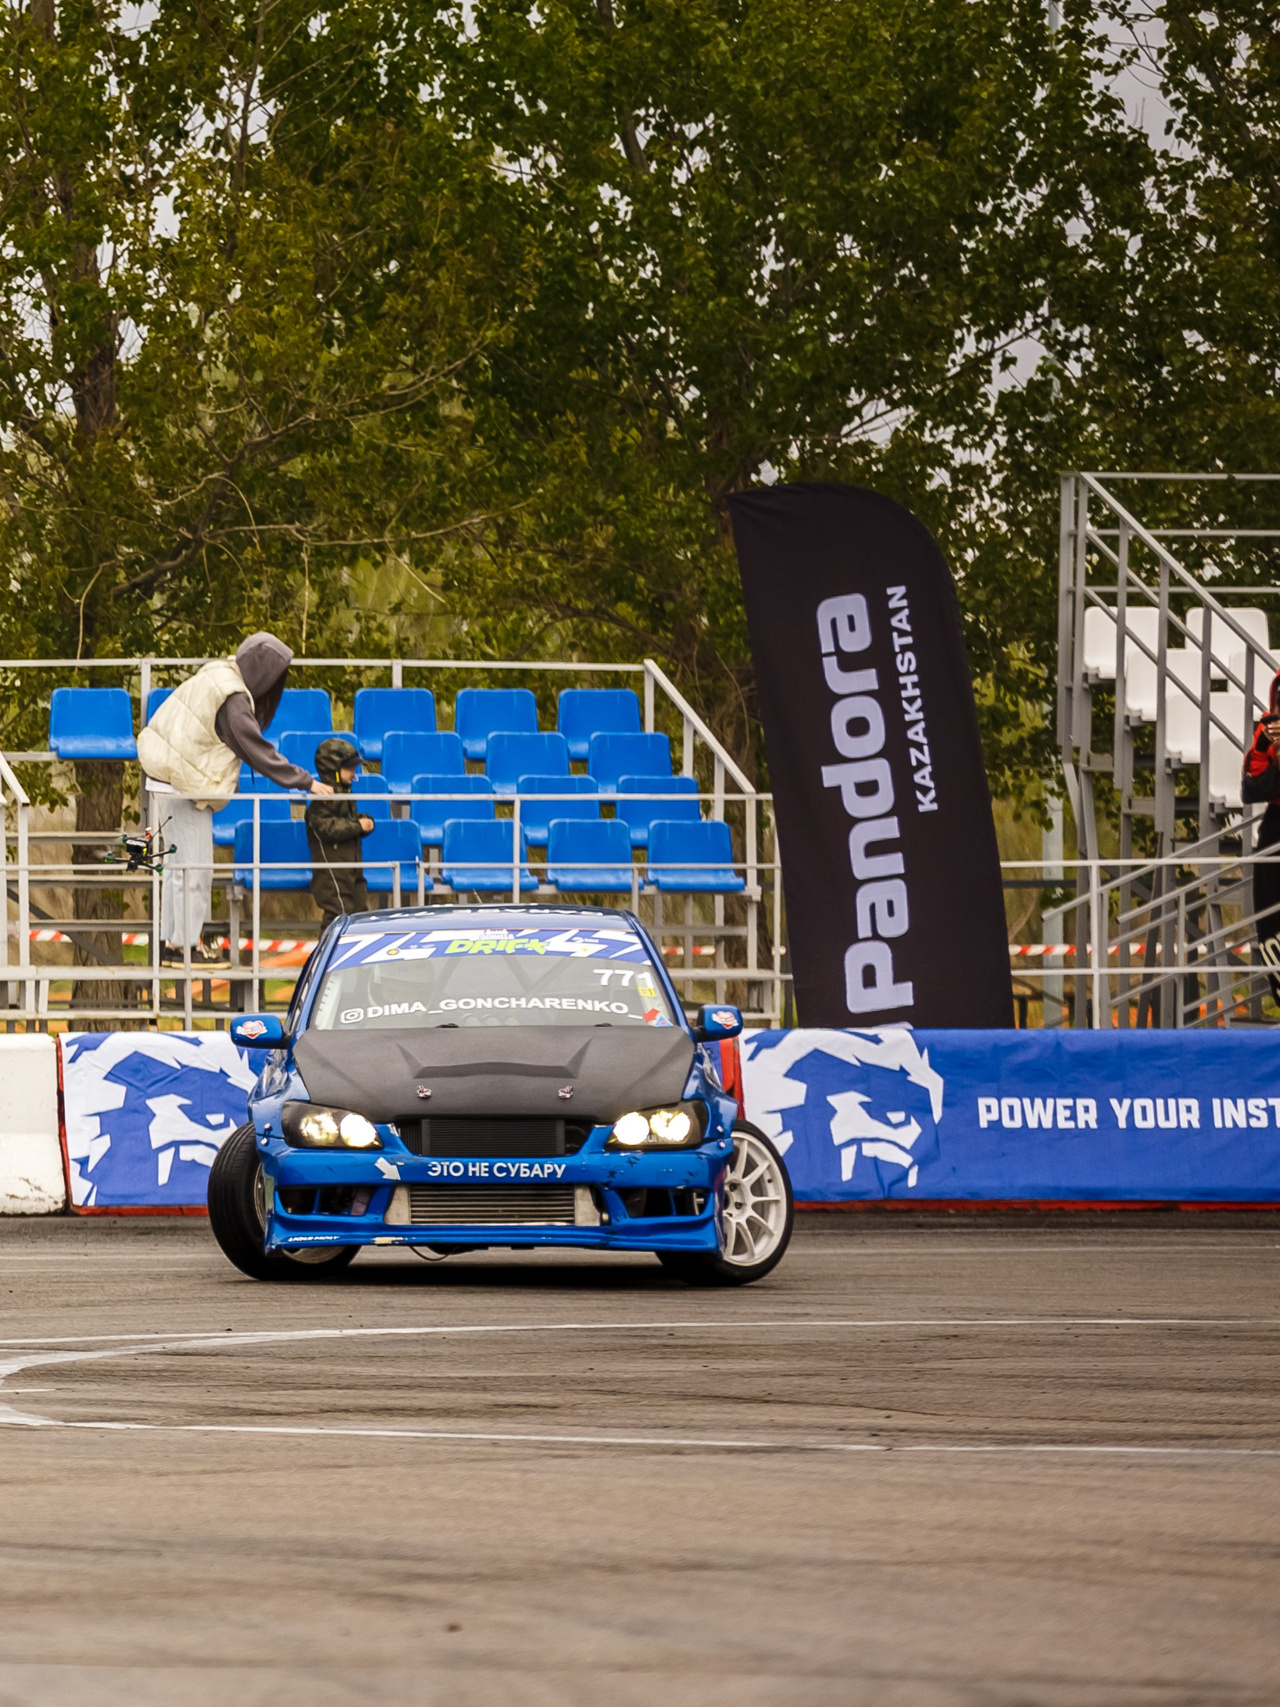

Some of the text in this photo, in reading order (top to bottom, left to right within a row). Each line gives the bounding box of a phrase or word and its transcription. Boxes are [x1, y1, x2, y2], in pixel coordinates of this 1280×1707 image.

[886, 585, 938, 812] KAZAKHSTAN
[593, 969, 654, 988] 771
[977, 1097, 1098, 1129] POWER
[1109, 1097, 1201, 1129] YOUR
[427, 1161, 567, 1179] ЭТО НЕ СУБАРУ
